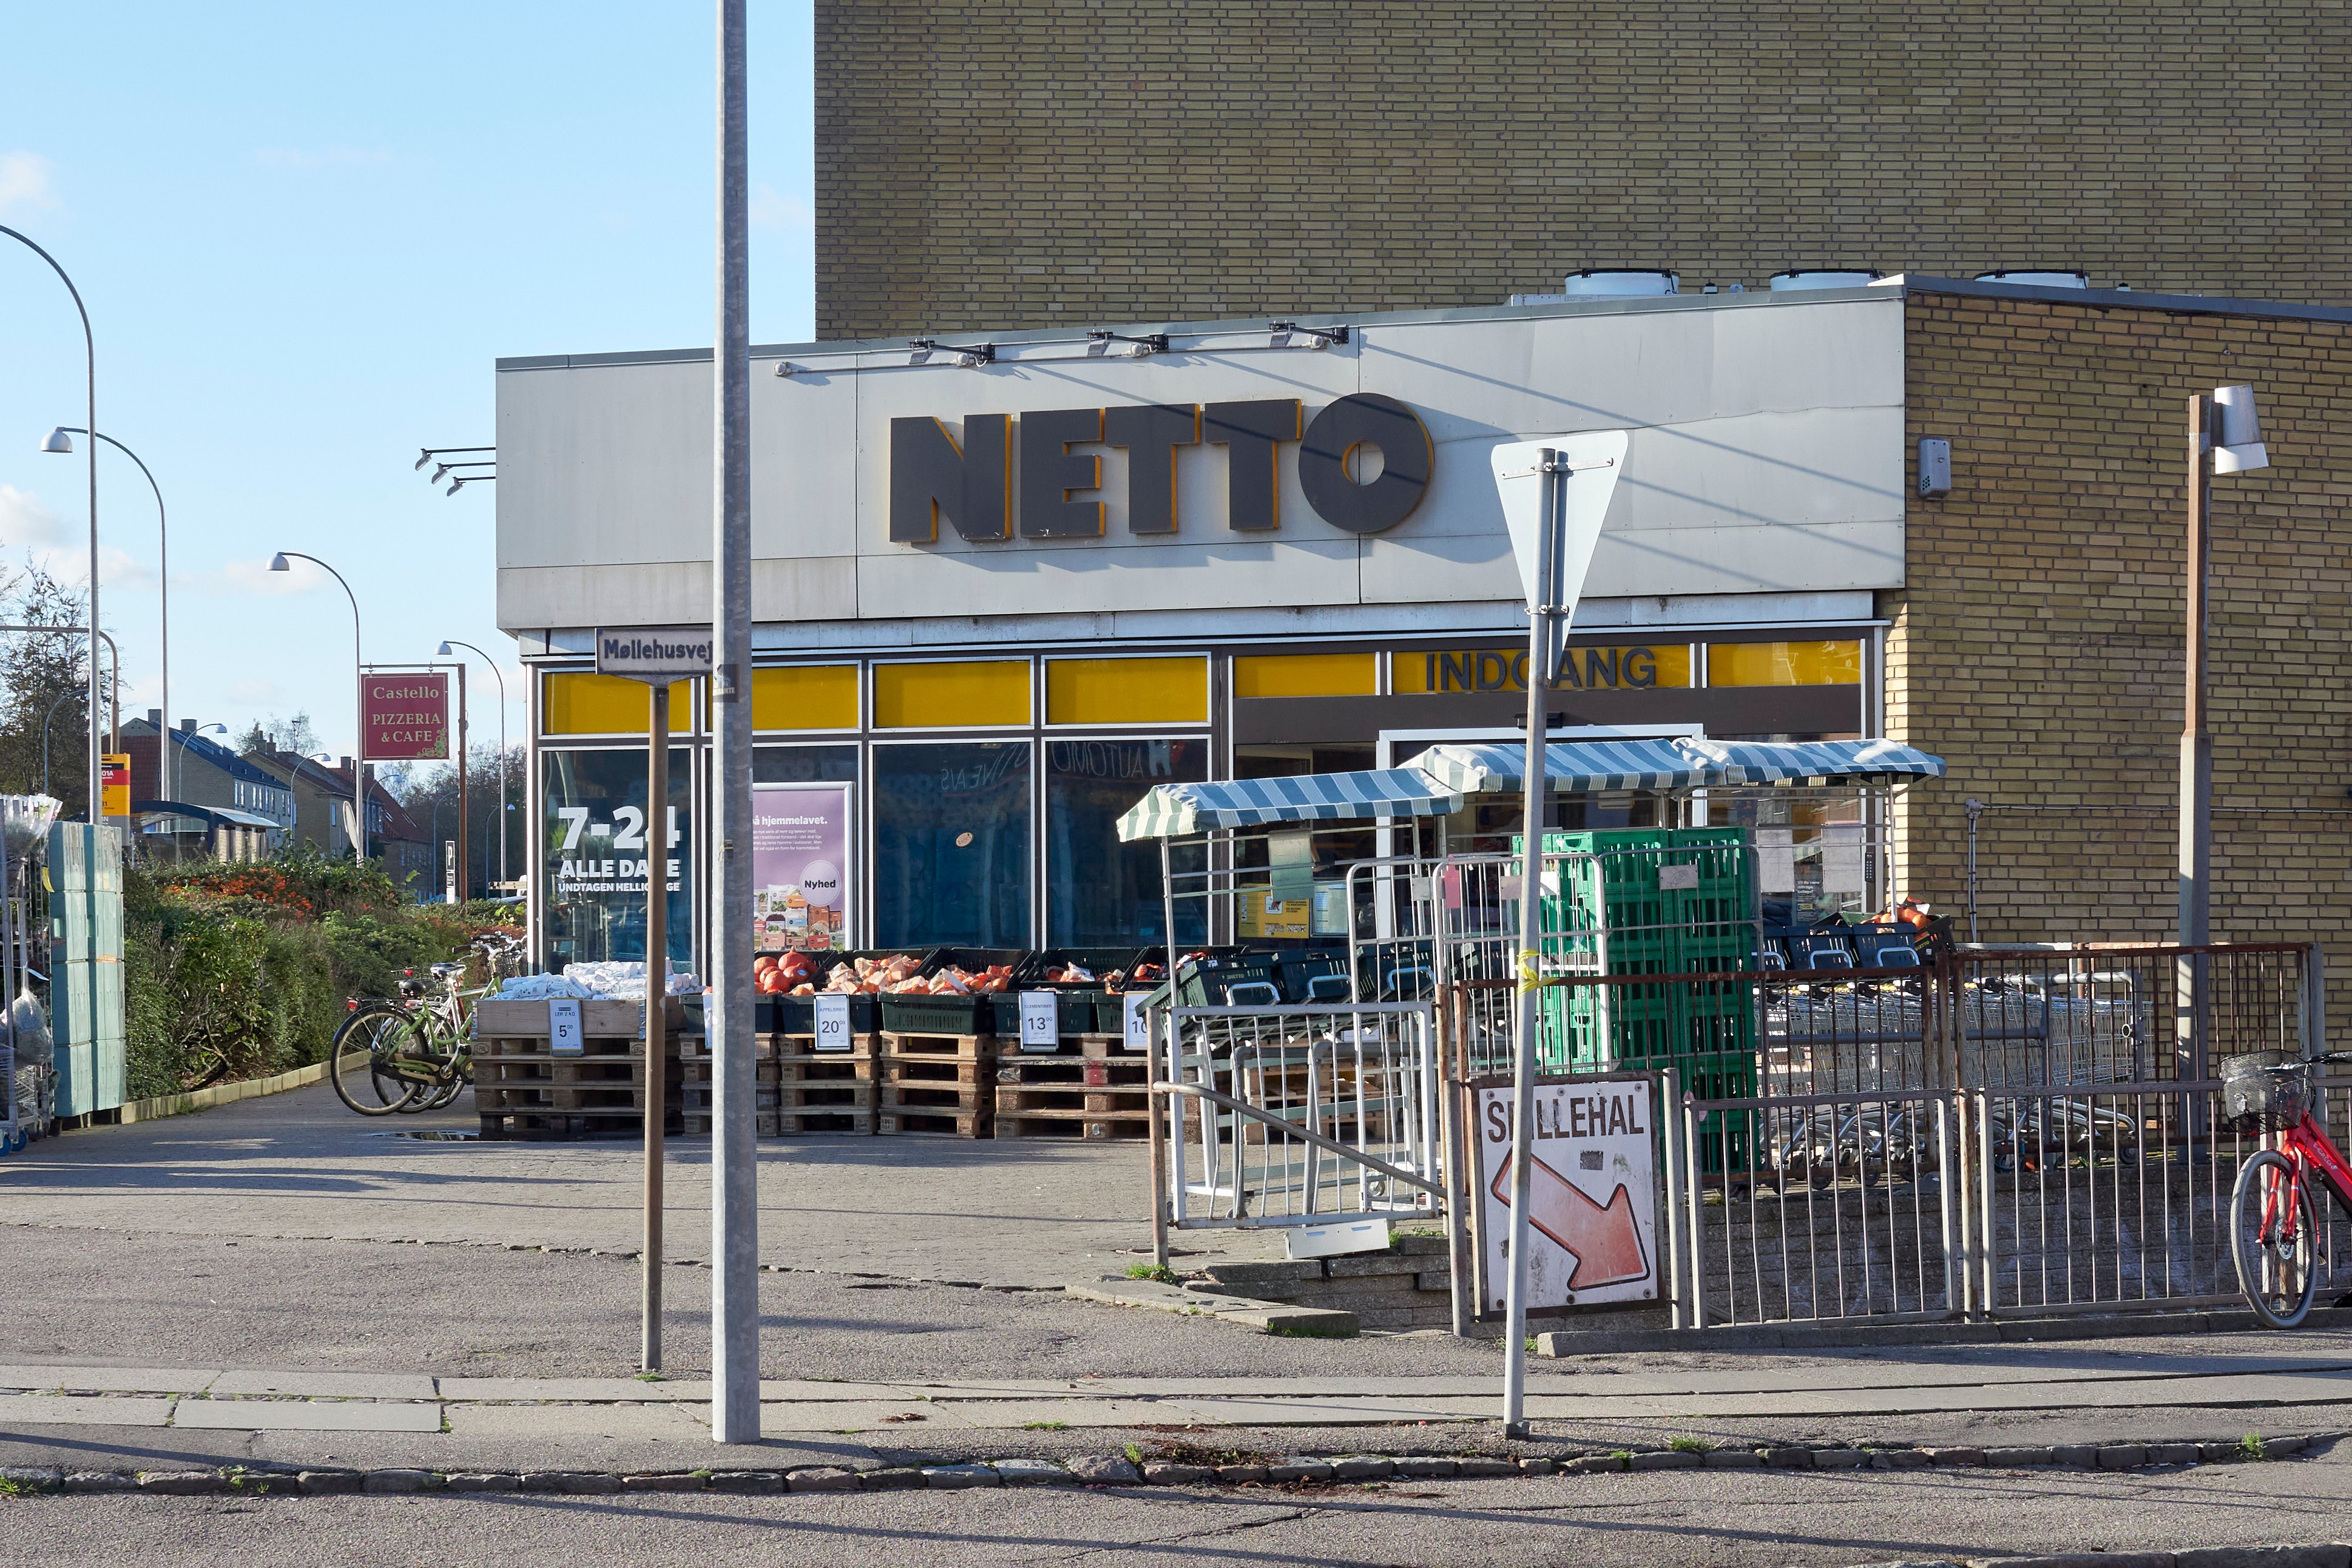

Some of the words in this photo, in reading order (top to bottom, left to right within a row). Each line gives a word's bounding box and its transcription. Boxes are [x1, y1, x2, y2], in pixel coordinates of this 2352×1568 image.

[890, 392, 1433, 543] NETTO
[604, 638, 713, 664] Møllehusvej
[373, 686, 439, 699] Castello
[372, 713, 442, 725] PIZZERIA
[381, 732, 390, 742] &
[393, 731, 432, 742] CAFE
[762, 815, 828, 827] hjemmelavet.
[559, 859, 614, 877] ALLE
[619, 859, 680, 877] DAE
[558, 882, 615, 892] UNDTAGEN
[804, 879, 836, 890] Nyhed
